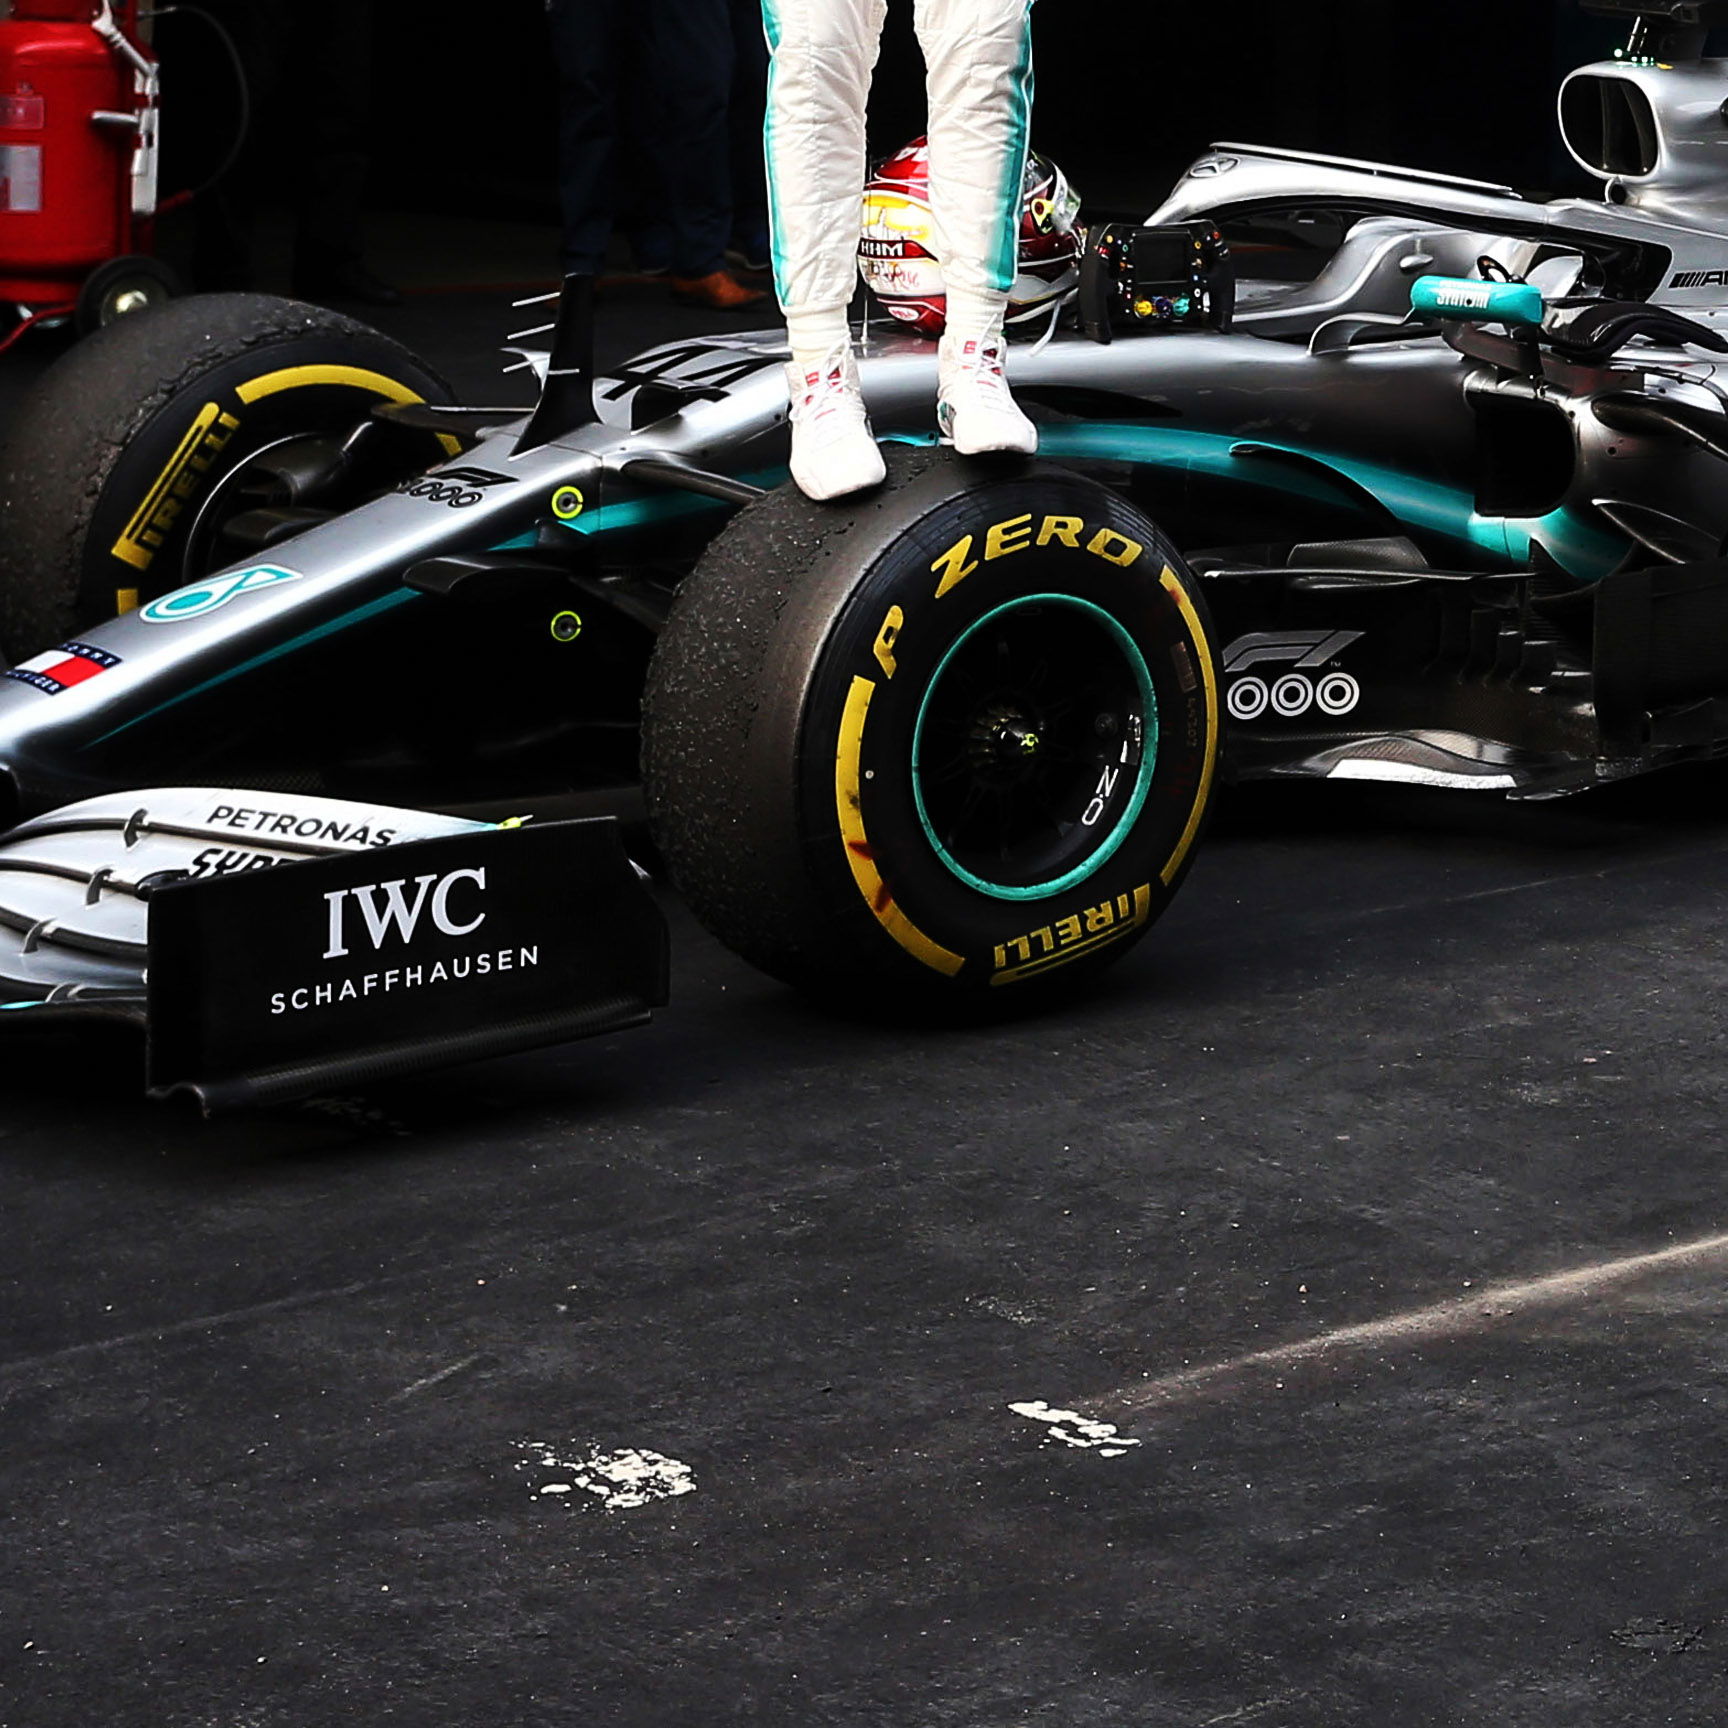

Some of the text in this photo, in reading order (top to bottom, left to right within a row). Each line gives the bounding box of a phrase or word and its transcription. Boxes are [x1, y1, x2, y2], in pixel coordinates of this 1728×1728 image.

[930, 513, 1143, 599] ZERO
[1226, 672, 1361, 721] 000
[205, 805, 397, 849] PETRONAS
[323, 866, 486, 959] IWC
[989, 882, 1150, 986] PIRELLI
[271, 945, 539, 1014] SCHAFFHAUSEN
